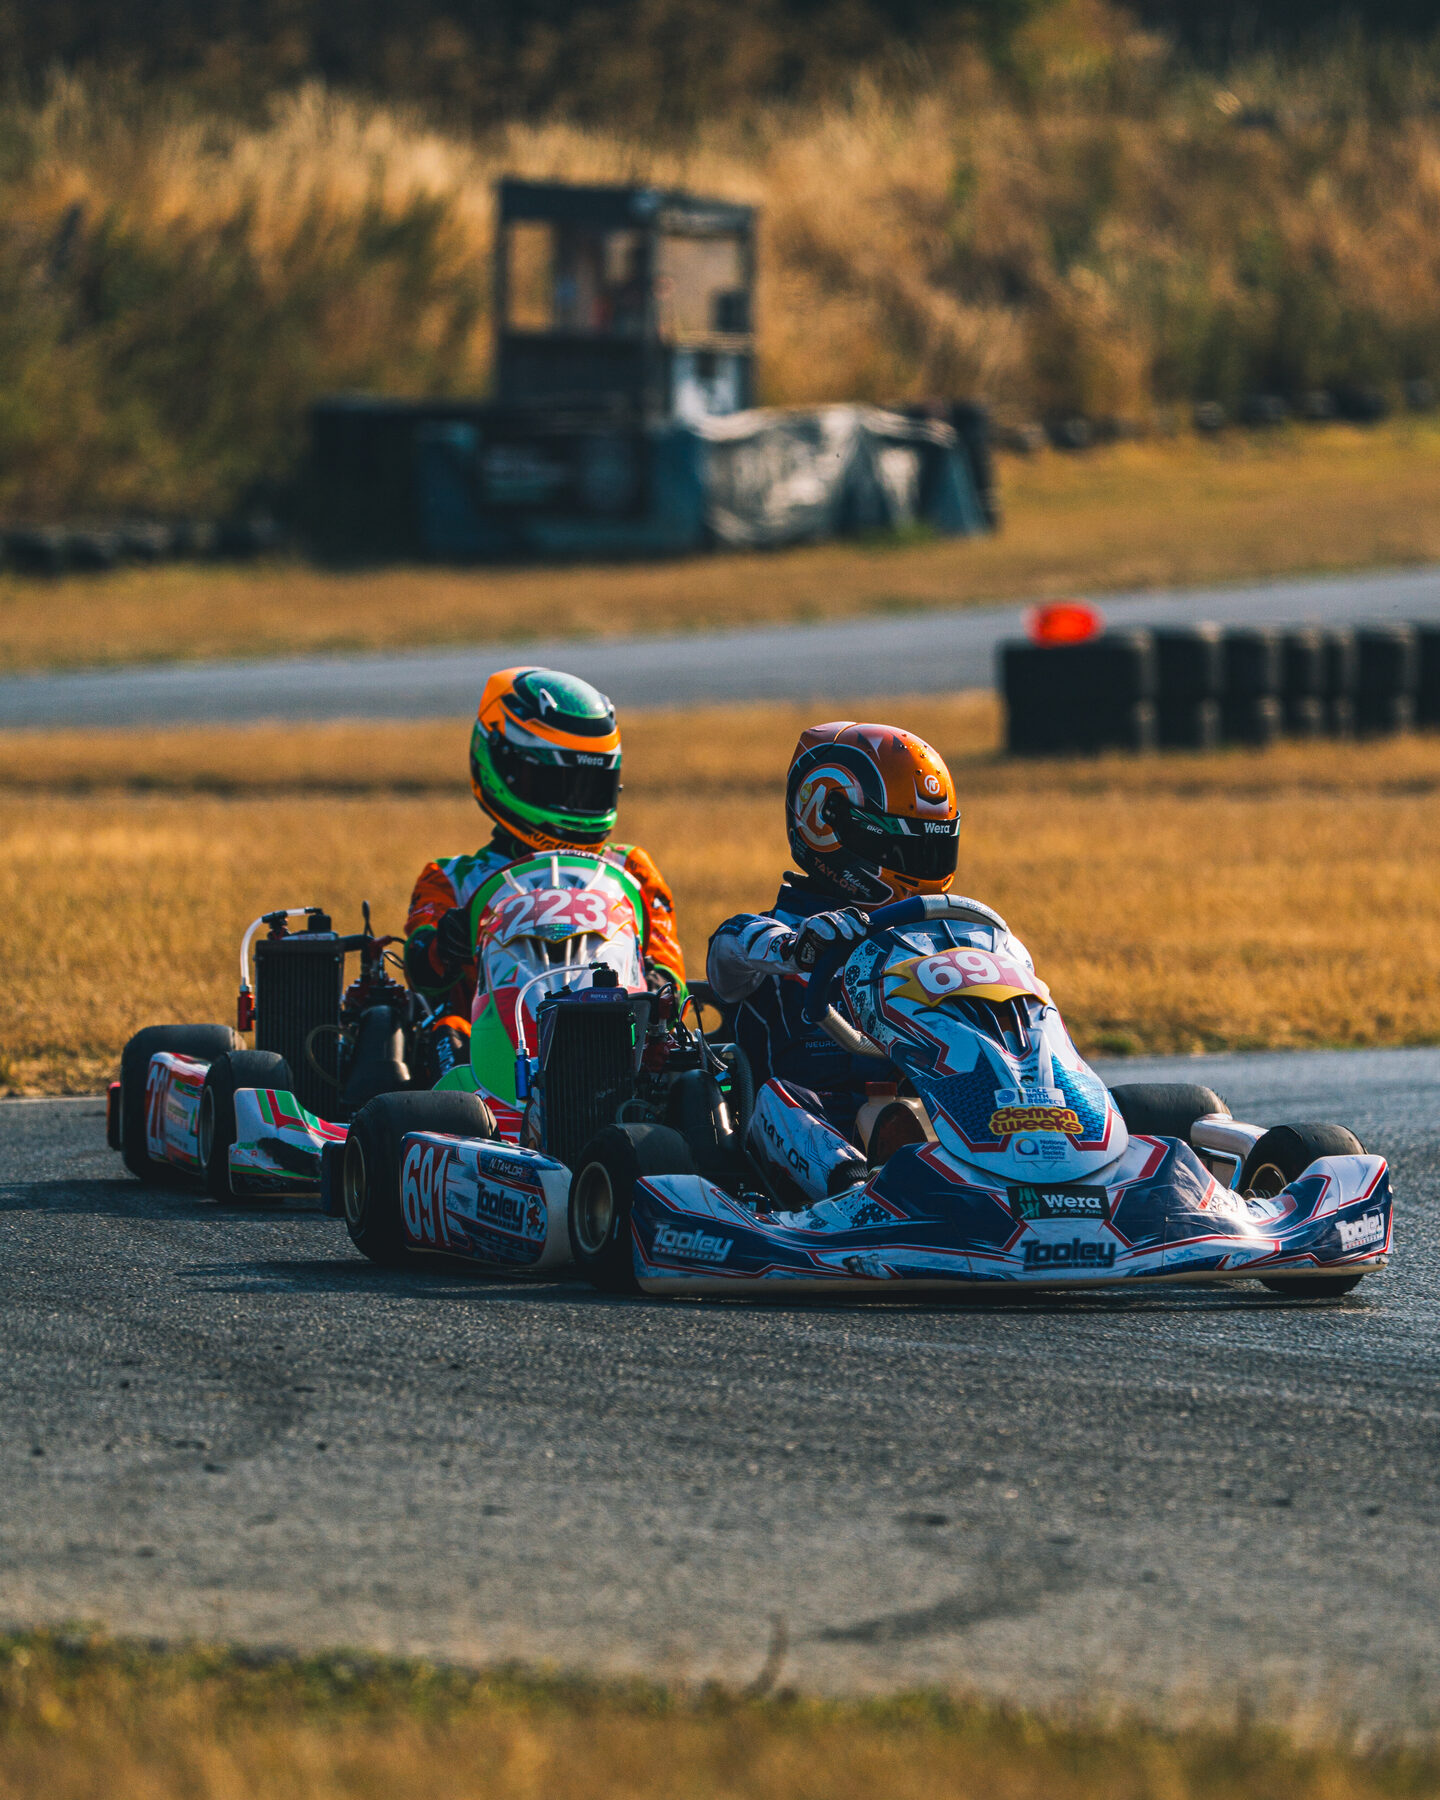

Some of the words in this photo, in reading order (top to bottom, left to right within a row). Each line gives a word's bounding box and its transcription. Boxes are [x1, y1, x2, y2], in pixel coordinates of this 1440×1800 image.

[576, 754, 604, 766] Wera
[924, 821, 951, 835] Wera
[813, 856, 858, 896] TAYLOR
[503, 889, 608, 944] 223
[916, 951, 1041, 996] 691
[993, 1107, 1077, 1122] demon
[1027, 1098, 1064, 1106] RESPECT
[991, 1119, 1082, 1134] tweeks
[403, 1143, 452, 1247] 691
[477, 1182, 525, 1231] Tooley
[1041, 1194, 1102, 1209] Wera
[655, 1223, 735, 1261] Tooley
[1334, 1213, 1384, 1246] Tooley
[1020, 1237, 1116, 1269] Tooley
